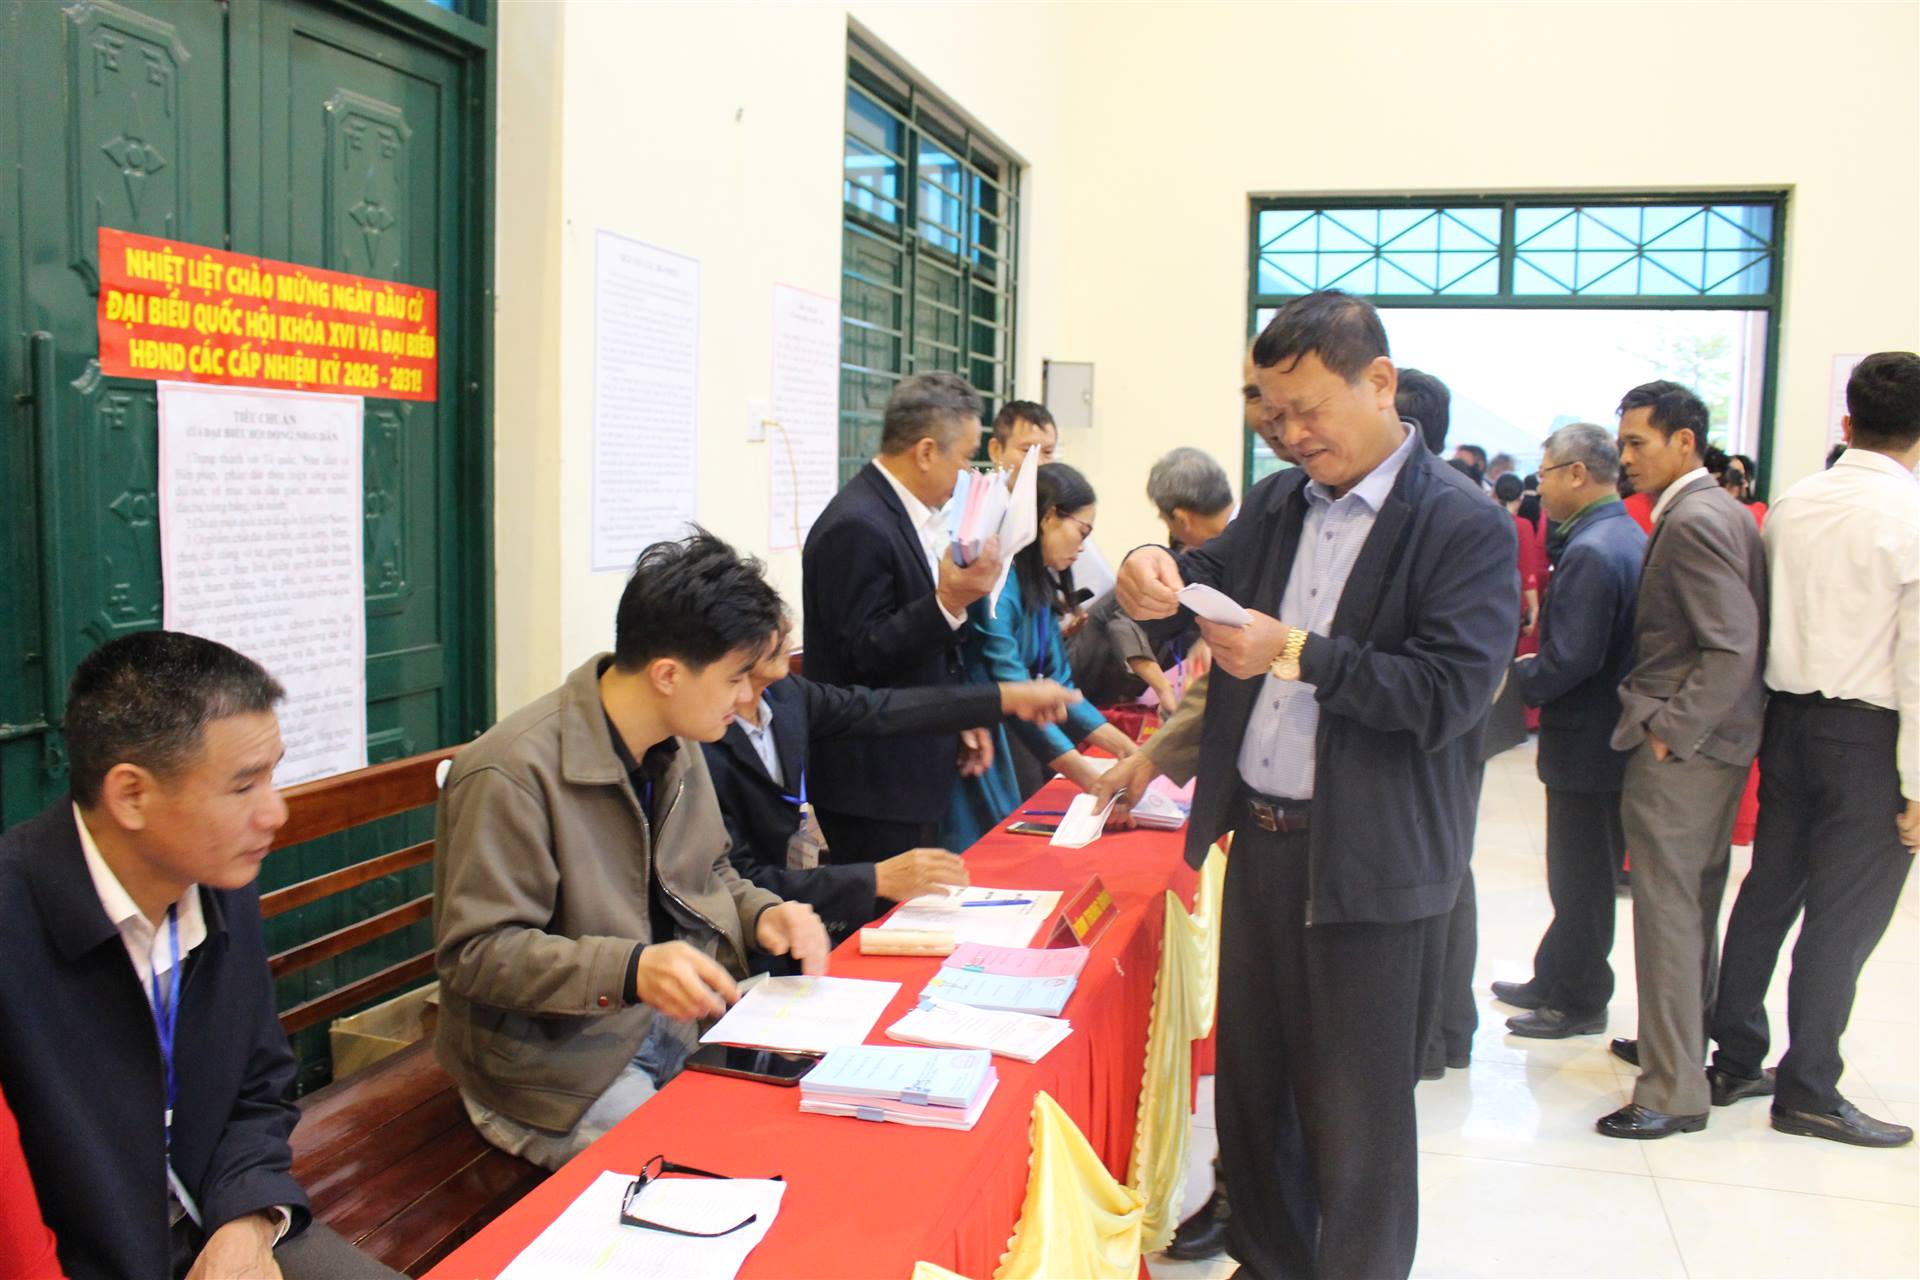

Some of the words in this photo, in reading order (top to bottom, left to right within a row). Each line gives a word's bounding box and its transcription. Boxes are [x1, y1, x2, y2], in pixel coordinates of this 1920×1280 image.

[125, 246, 185, 290] NHIỆT
[187, 253, 224, 297] LIỆT
[226, 262, 274, 299] CHÀO
[277, 270, 330, 309] MỪNG
[332, 280, 373, 314] NGÀY
[375, 284, 406, 319] BẦU
[106, 290, 144, 330] ĐẠI
[148, 288, 190, 329] BIỂU
[193, 297, 243, 335] QUỐC
[245, 304, 276, 346] HỘI
[279, 311, 325, 346] KHÓA
[328, 321, 355, 349] XVI
[358, 320, 379, 352] VÀ
[381, 329, 406, 361] ĐẠI
[406, 325, 436, 359] BIỂU
[128, 338, 186, 372] HĐND
[188, 338, 225, 376] CÁC
[227, 342, 262, 378] CẤP
[263, 349, 317, 389] NHIỆM
[320, 352, 341, 385] KỲ
[343, 361, 379, 389] 2026
[381, 376, 388, 384] -
